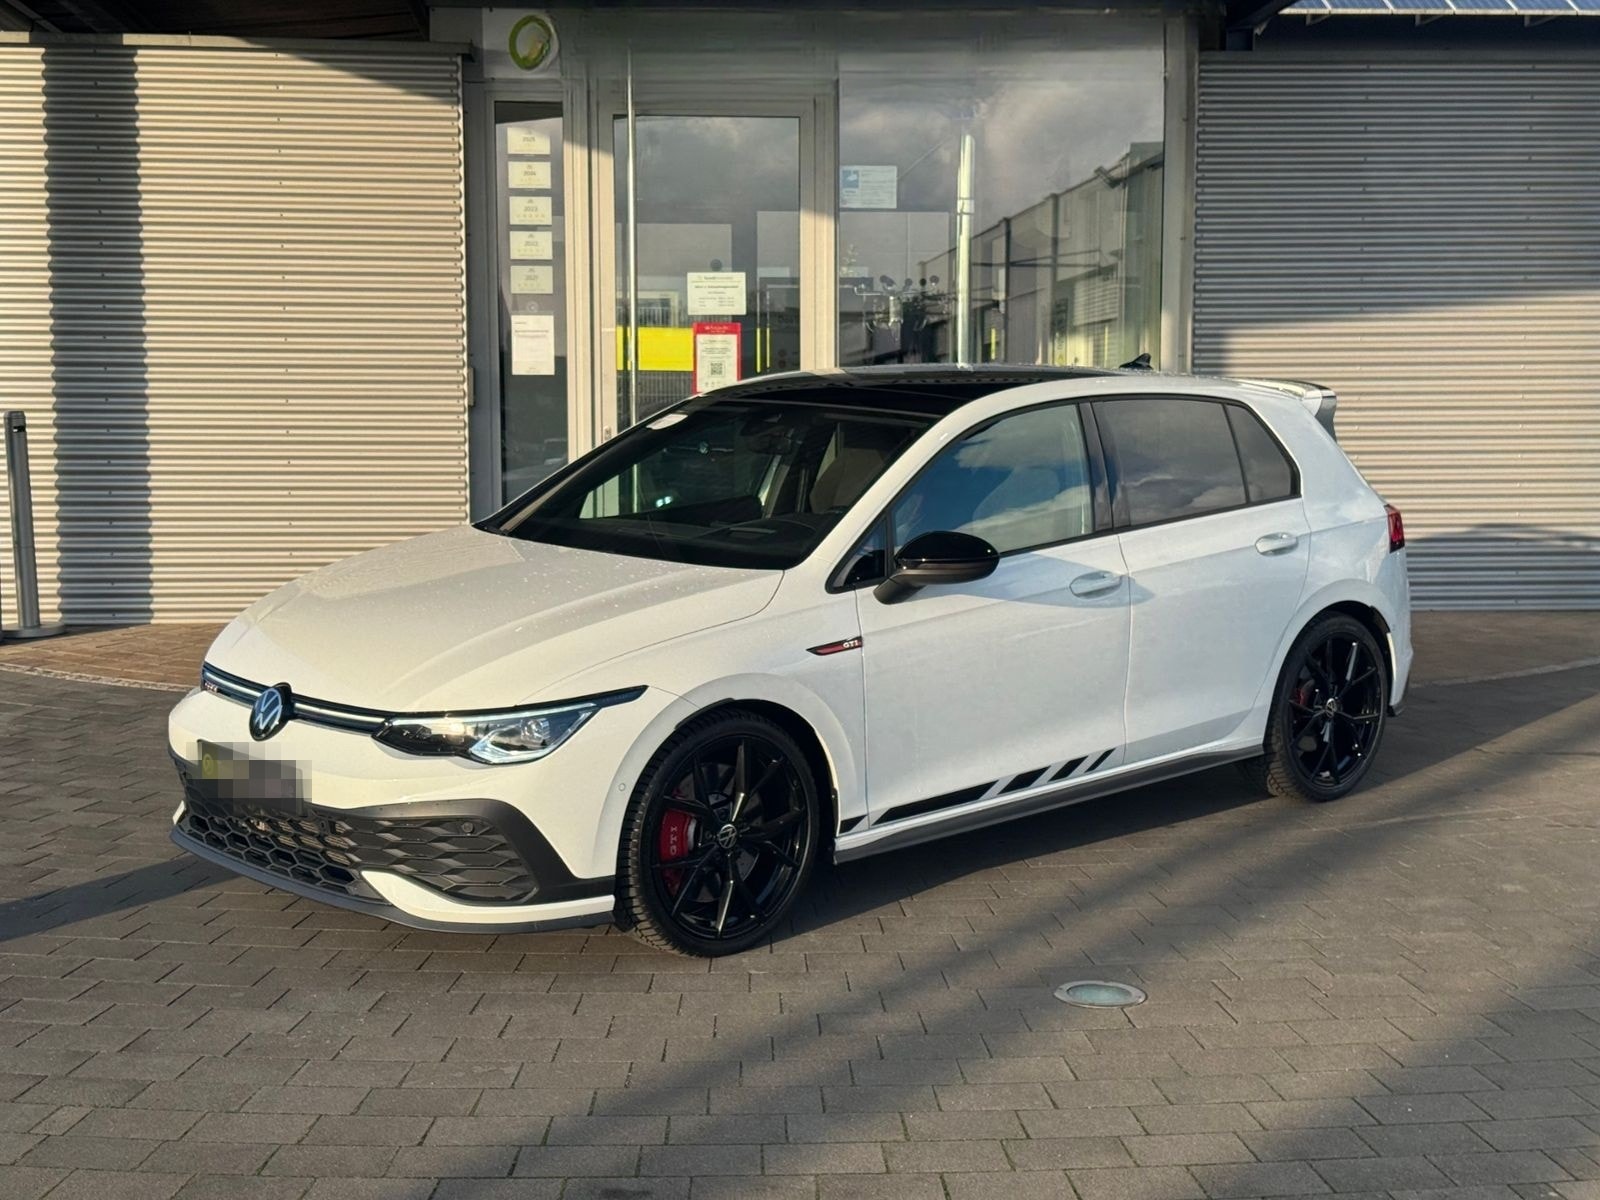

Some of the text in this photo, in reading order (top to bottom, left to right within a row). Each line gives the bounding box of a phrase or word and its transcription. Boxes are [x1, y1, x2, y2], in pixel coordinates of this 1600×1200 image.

[843, 639, 859, 648] GTI
[254, 687, 283, 737] VW
[669, 825, 678, 856] GTI
